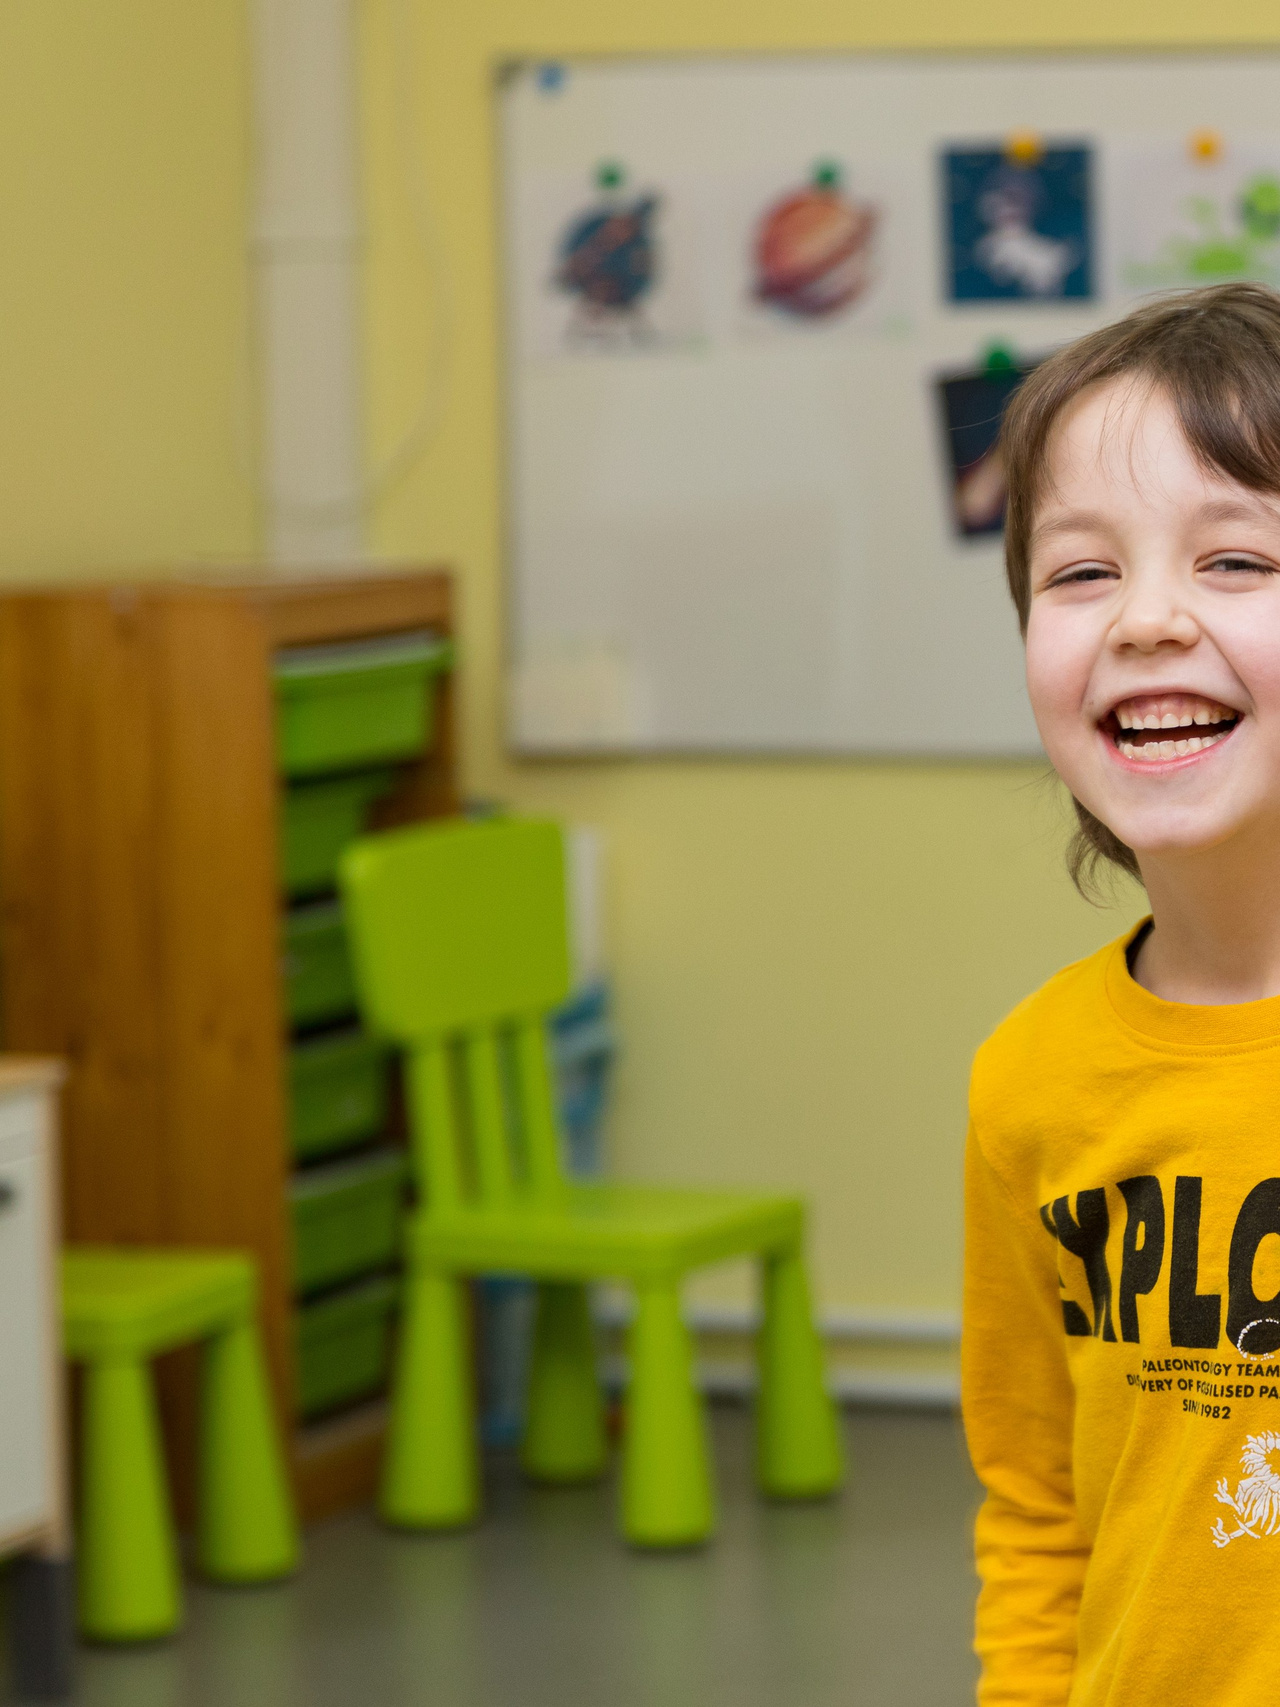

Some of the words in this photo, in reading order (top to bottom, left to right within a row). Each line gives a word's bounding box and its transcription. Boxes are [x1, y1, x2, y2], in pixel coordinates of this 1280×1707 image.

[1142, 1358, 1232, 1377] PALEONTOGY
[1236, 1363, 1280, 1378] TEAM
[1126, 1374, 1173, 1392] DISVERY
[1177, 1378, 1194, 1392] OF
[1196, 1380, 1255, 1398] FOSILISED
[1182, 1398, 1200, 1415] SIN
[1200, 1403, 1232, 1420] 1982
